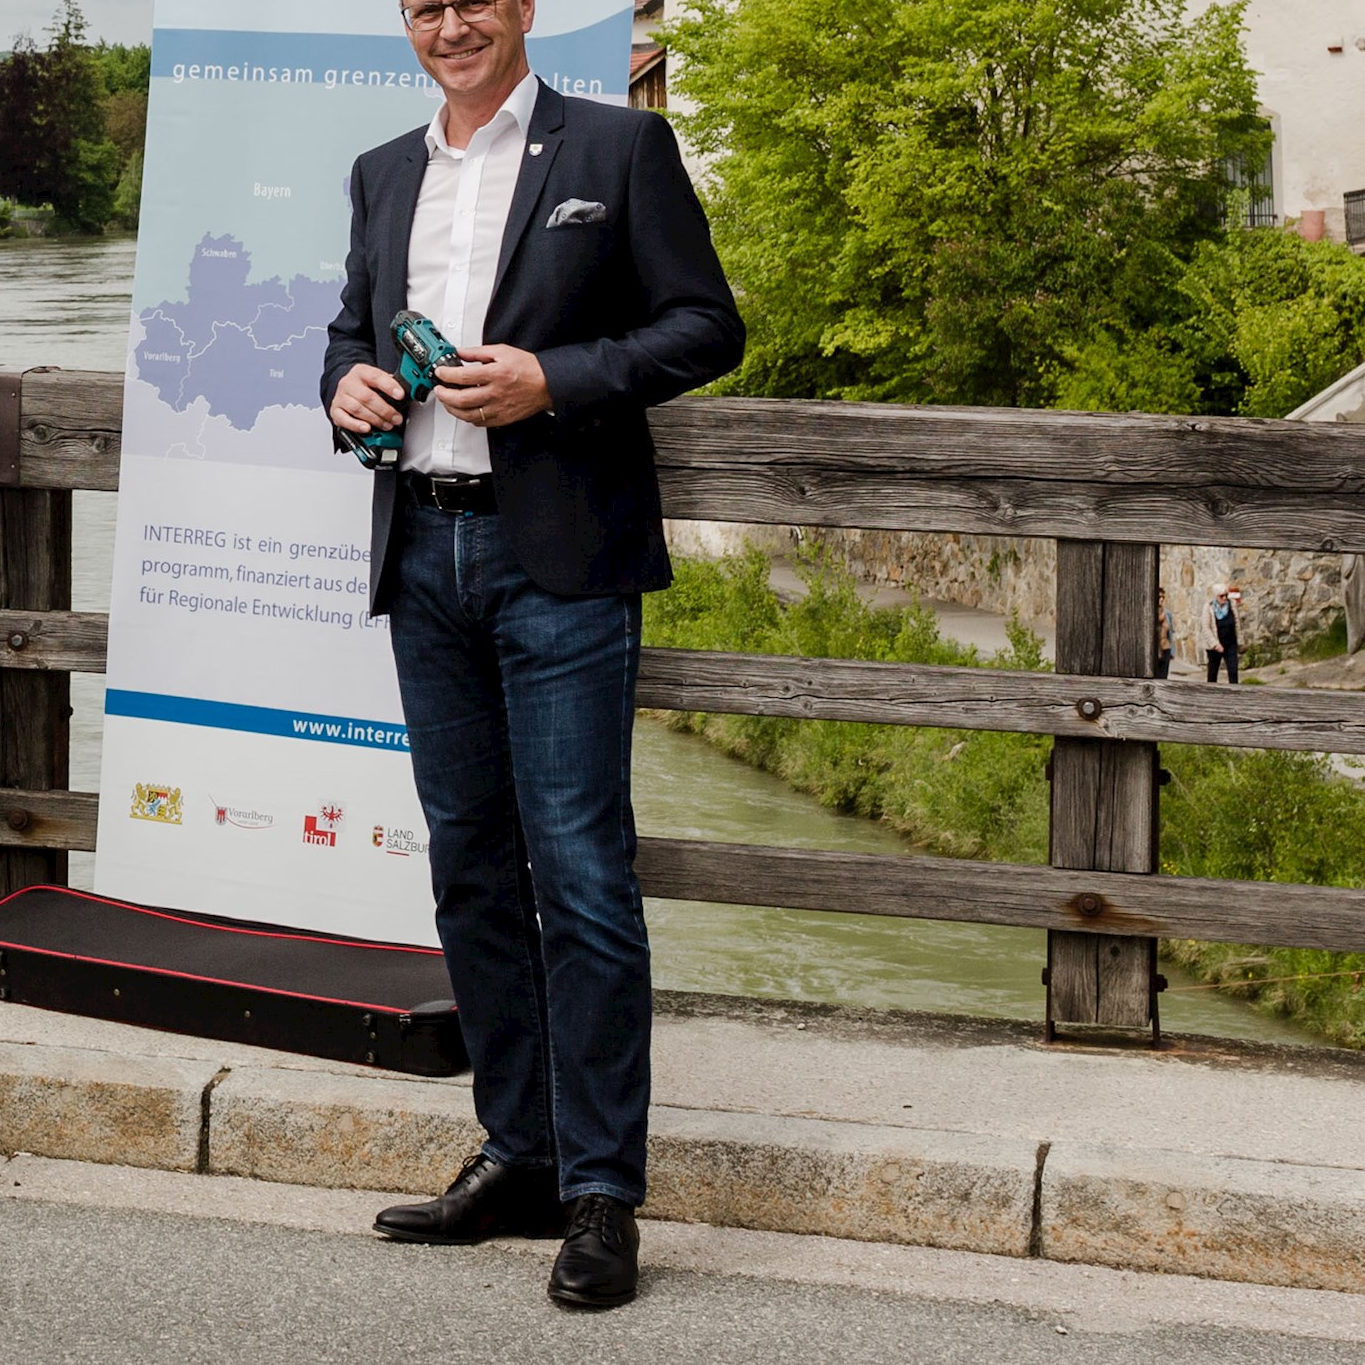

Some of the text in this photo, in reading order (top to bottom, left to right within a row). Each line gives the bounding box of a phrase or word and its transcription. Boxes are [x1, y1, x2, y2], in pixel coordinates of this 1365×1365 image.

[172, 61, 314, 86] gemeinsam
[253, 181, 292, 199] Bayern
[143, 350, 181, 363] Vorarlberg
[144, 524, 226, 548] INTERREG
[233, 533, 252, 551] ist
[258, 536, 282, 554] ein
[141, 558, 233, 583] programm,
[236, 564, 310, 589] finanziert
[313, 576, 342, 593] aus
[140, 586, 164, 604] für
[169, 589, 248, 614] Regionale
[252, 599, 353, 629] Entwicklung
[229, 807, 274, 824] Vorarlberg
[304, 829, 332, 847] tirol
[387, 827, 414, 841] LAND
